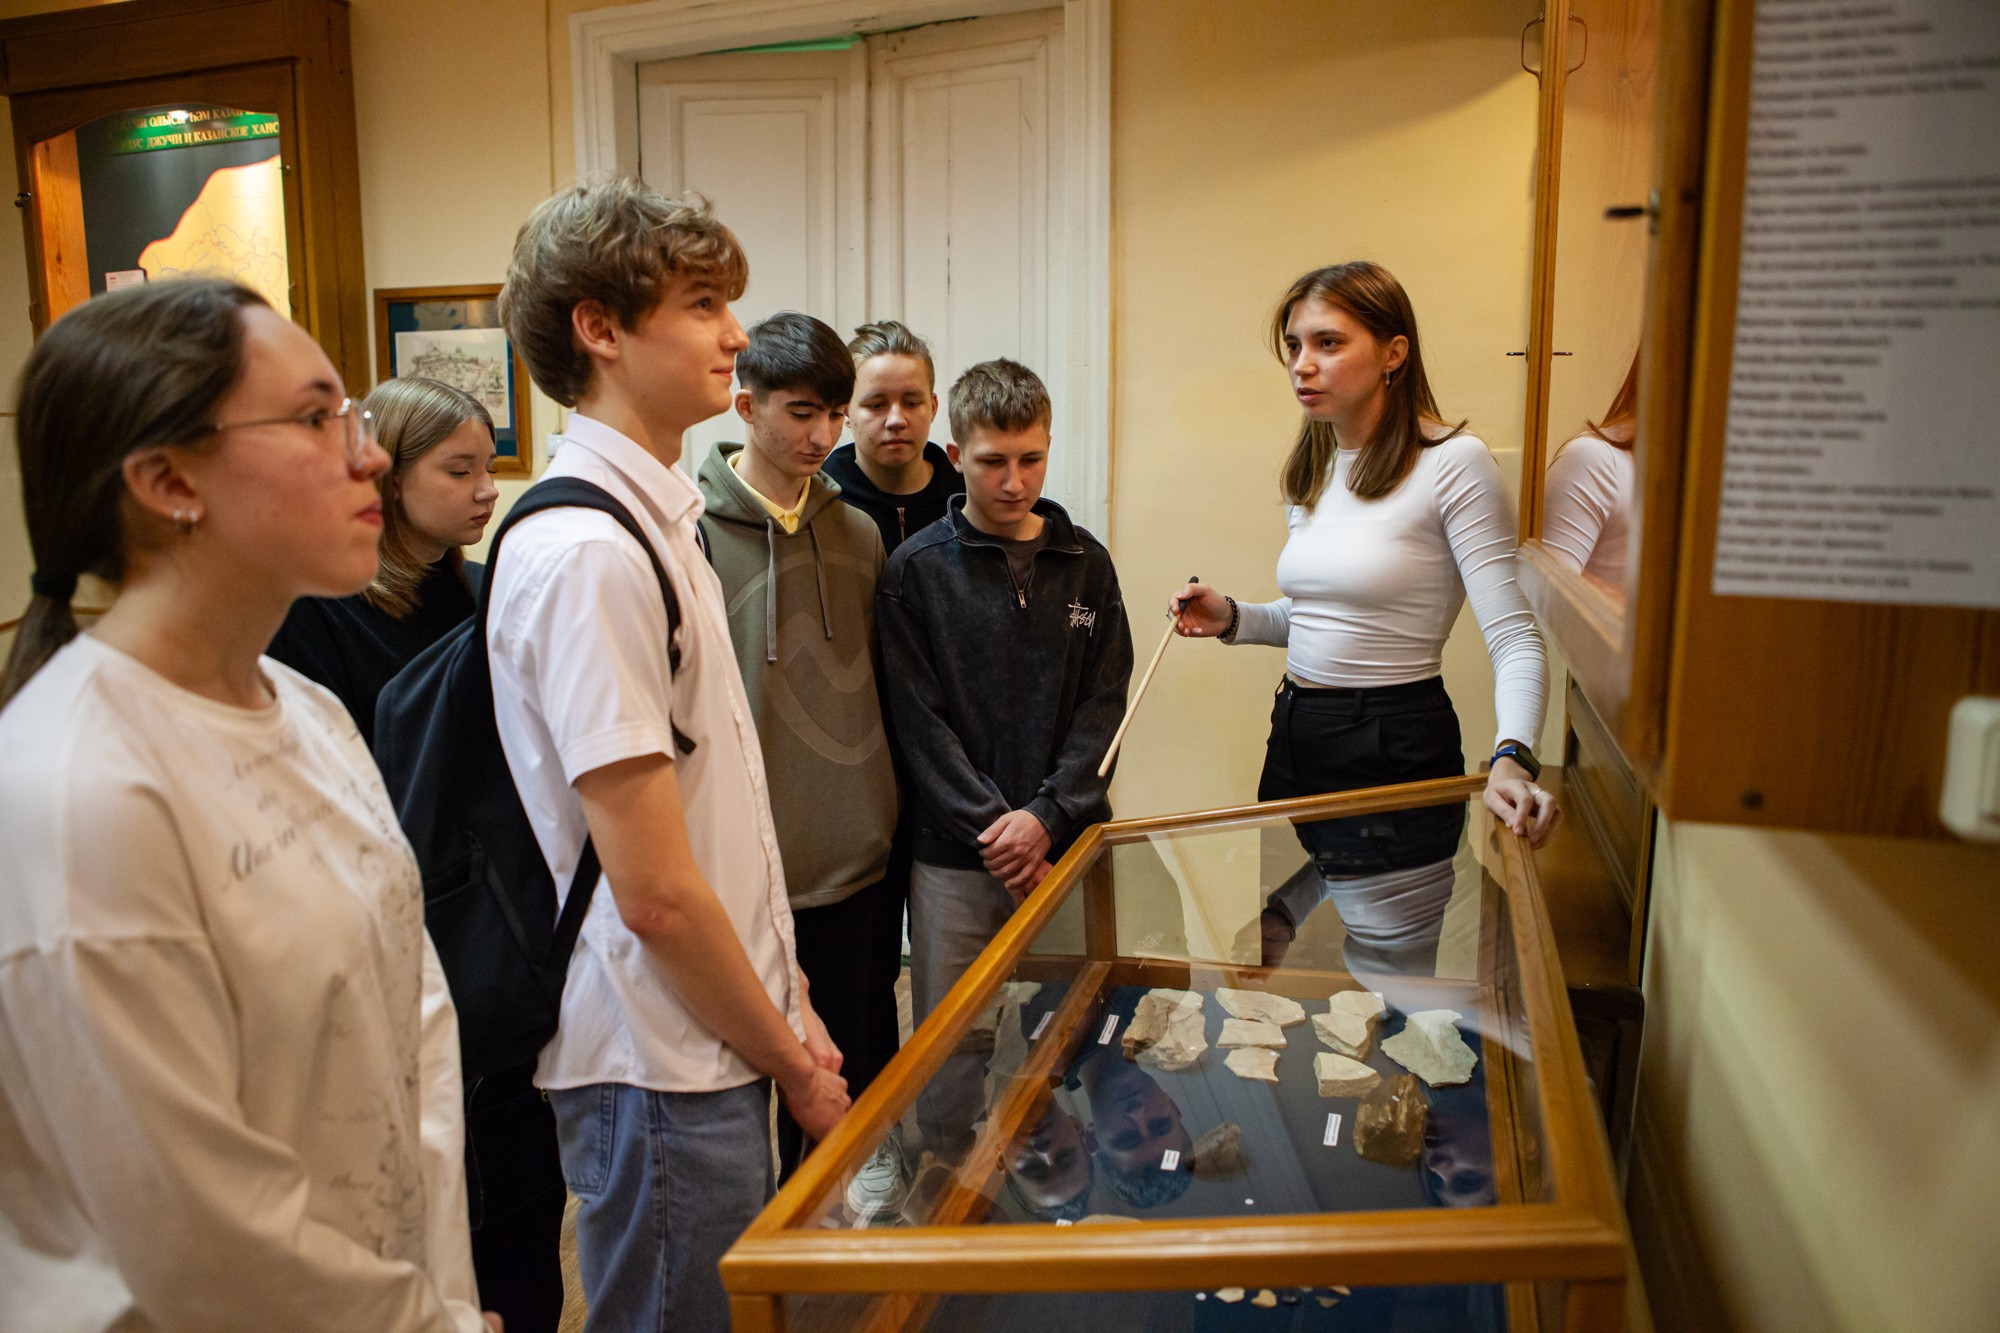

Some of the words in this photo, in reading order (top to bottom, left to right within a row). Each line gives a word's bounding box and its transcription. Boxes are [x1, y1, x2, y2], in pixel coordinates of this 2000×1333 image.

[147, 133, 183, 148] ДЖУЧИ
[184, 131, 193, 144] И
[194, 126, 248, 142] КАЗАНСКОЕ
